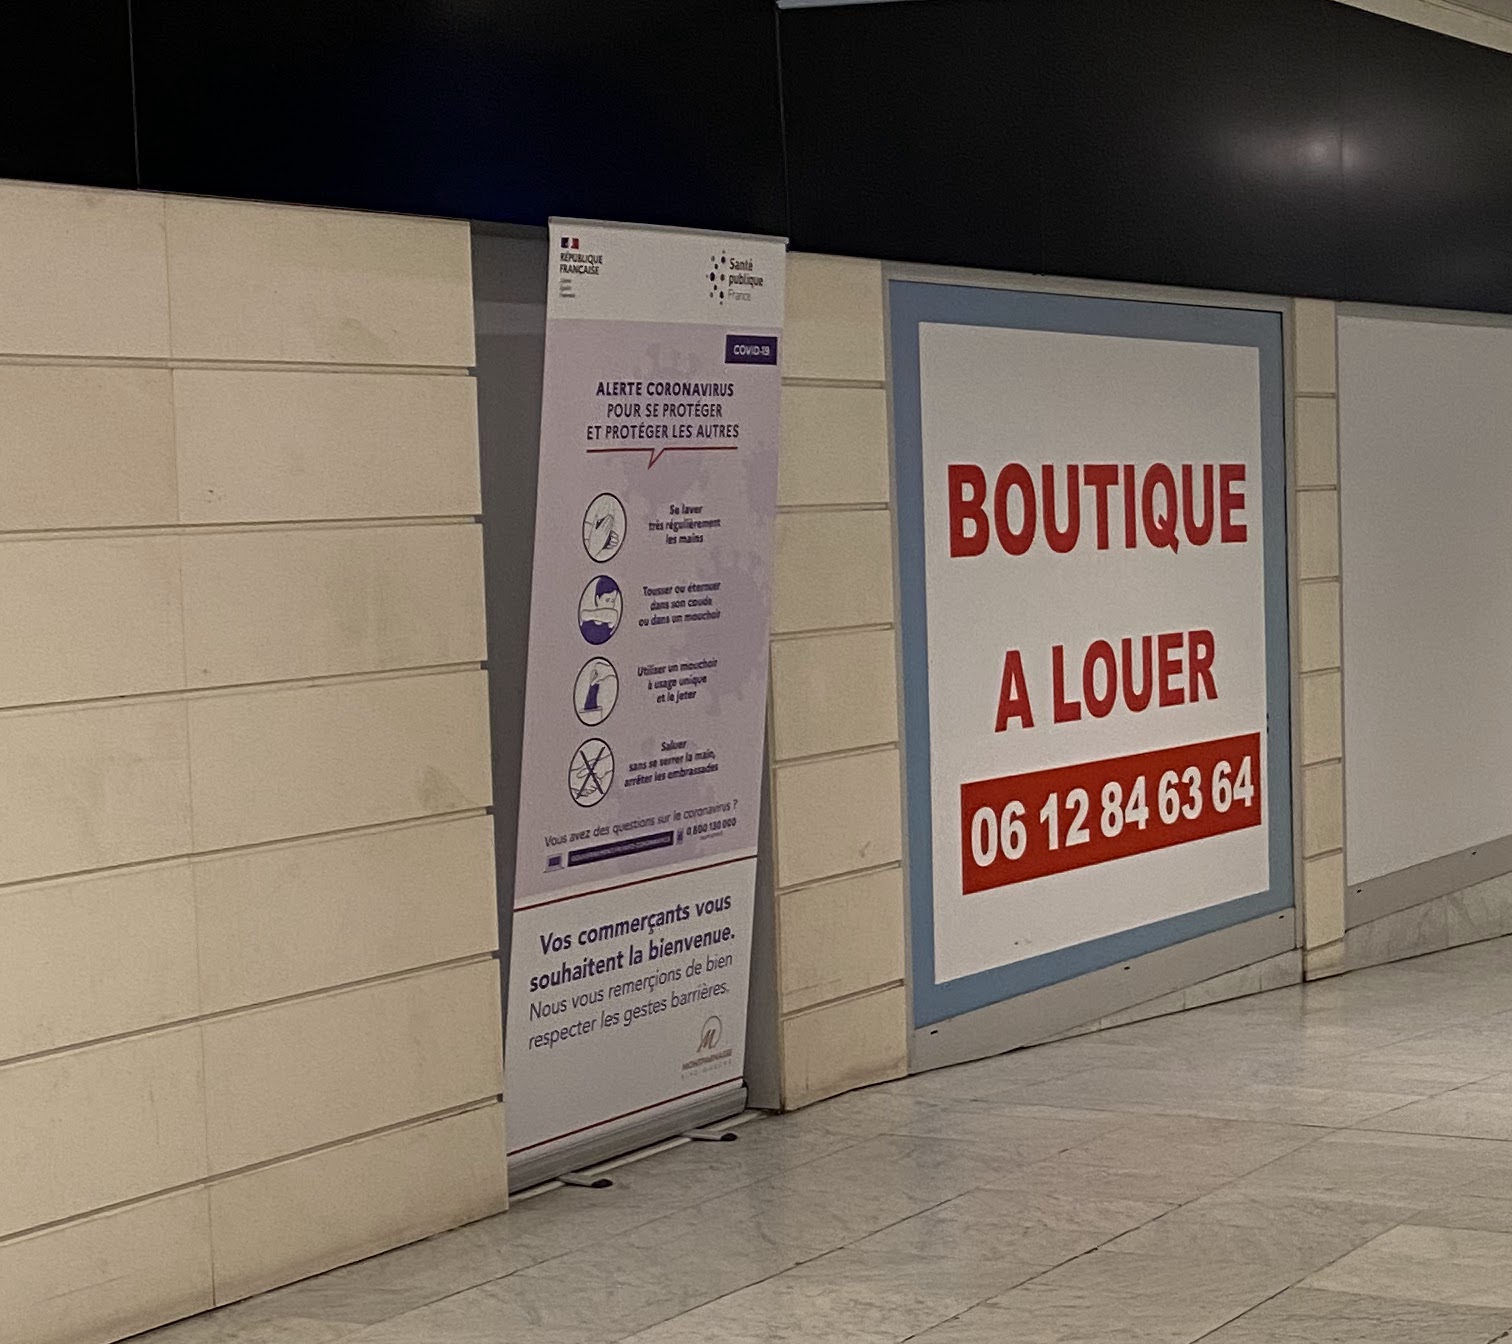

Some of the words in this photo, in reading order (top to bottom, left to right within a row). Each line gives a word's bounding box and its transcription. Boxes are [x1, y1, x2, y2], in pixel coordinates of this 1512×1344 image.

[728, 273, 764, 288] publique
[729, 257, 754, 271] Santé
[733, 345, 770, 356] COVID-19
[596, 382, 642, 396] ALERTE
[646, 382, 734, 397] CORONAVIRUS
[607, 403, 641, 418] POUR
[645, 403, 659, 418] SE
[662, 399, 723, 418] PROTÉGER
[587, 425, 602, 440] ET
[605, 422, 668, 440] PROTÉGER
[672, 424, 692, 438] LES
[696, 424, 739, 439] AUTRES
[948, 463, 1247, 558] BOUTIQUE
[995, 650, 1034, 732] A
[1051, 629, 1218, 724] LOUER
[544, 835, 567, 847] Vous
[569, 830, 590, 842] avez
[594, 824, 610, 836] des
[613, 817, 655, 835] questions
[658, 814, 671, 824] sur
[673, 810, 681, 821] le
[683, 801, 731, 820] coronavirus
[971, 800, 1027, 867] 06
[1039, 788, 1090, 851] 12
[1101, 776, 1149, 838] 84
[1158, 766, 1202, 824] 63
[1211, 756, 1254, 814] 64
[540, 933, 571, 955] Vos
[578, 903, 690, 946] commerçants
[695, 895, 731, 916] vous
[530, 952, 623, 992] souhaitent
[629, 946, 643, 965] la
[649, 925, 735, 961] bienvenue.
[530, 1000, 567, 1023] Nous
[571, 989, 604, 1008] vous
[609, 967, 681, 998] remerçions
[684, 959, 703, 977] de
[706, 953, 733, 972] bien
[528, 1019, 597, 1049] respecter
[600, 1010, 619, 1028] les
[623, 999, 667, 1026] gestes
[671, 982, 730, 1008] barrières.
